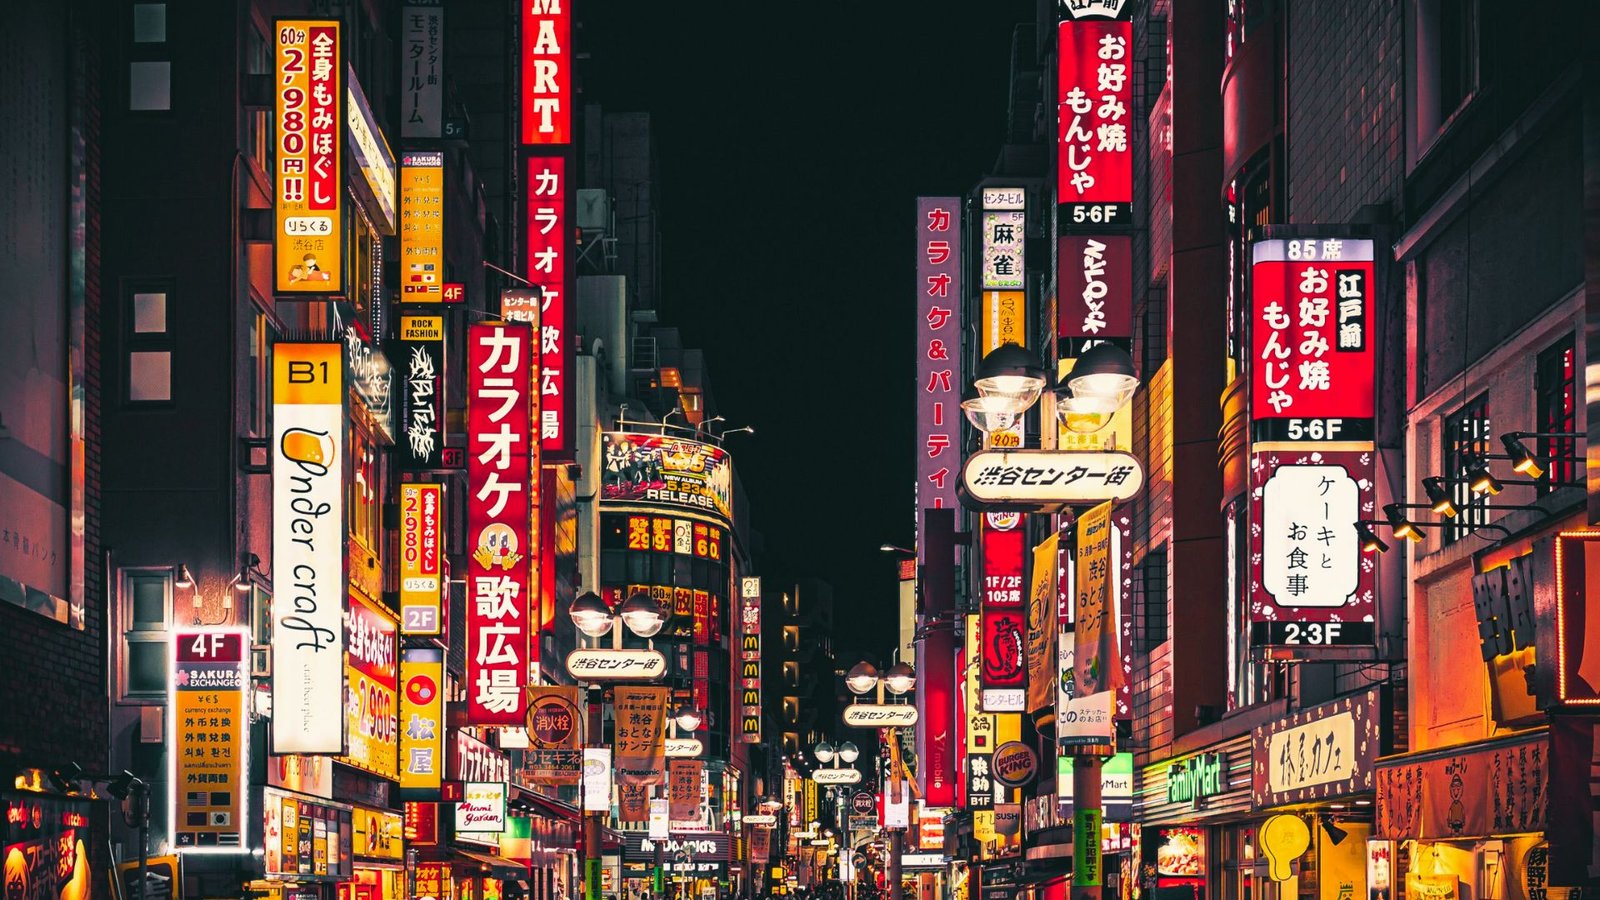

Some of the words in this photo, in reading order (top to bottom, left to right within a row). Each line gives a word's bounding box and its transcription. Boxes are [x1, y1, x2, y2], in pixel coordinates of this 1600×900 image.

[280, 28, 306, 45] 60分
[427, 15, 439, 86] 渋谷センター街
[408, 14, 425, 124] モニタールーム
[1097, 33, 1127, 153] お好み焼
[312, 32, 334, 205] 全身もみほぐし
[1064, 86, 1095, 195] もんじゃ
[983, 193, 1024, 205] センタービル
[1012, 212, 1024, 222] 5F
[288, 219, 330, 233] りらくる
[292, 238, 325, 252] 渋谷店
[993, 223, 1014, 276] 麻雀
[444, 287, 463, 300] 4F
[1338, 273, 1363, 349] 江戸前
[411, 319, 433, 328] ROCK
[1299, 266, 1330, 392] お好み焼
[406, 329, 439, 338] FASHION
[926, 208, 951, 510] カラオケ&パーティー
[1261, 301, 1294, 415] もんじゃ
[288, 360, 328, 384] B1
[476, 327, 522, 519] カラオケ
[991, 435, 1020, 447] 90円
[444, 452, 461, 466] 3F
[681, 477, 702, 485] ALBUM
[973, 465, 1136, 487] 渋谷センター街
[667, 480, 700, 495] 5.23
[647, 488, 714, 508] RELEASE
[993, 512, 1015, 523] KING
[1316, 475, 1336, 570] ケーキと
[423, 491, 436, 572] 全身もみほぐし
[1286, 521, 1310, 598] お食事
[405, 580, 434, 590] りらくる
[985, 576, 1022, 588] 1F/2F
[986, 590, 1021, 603] 105席
[280, 564, 336, 653] craft
[408, 610, 433, 627] 2F
[191, 633, 225, 658] 4F
[474, 575, 521, 714] 歌広場
[572, 658, 660, 670] 渋谷センター街
[190, 670, 241, 679] SAKURA
[190, 678, 234, 687] EXCHANGE
[983, 694, 1024, 707] センタービル
[536, 715, 569, 731] 消火栓
[629, 713, 653, 726] 渋谷
[1060, 711, 1077, 724] この
[618, 726, 662, 739] おとなり
[406, 714, 437, 774] 松屋
[618, 741, 663, 752] サンデー
[664, 744, 699, 752] ンター街
[998, 751, 1030, 765] BURGER
[621, 768, 660, 777] Panasonic
[1000, 760, 1032, 775] KING
[1167, 752, 1222, 811] FamilyMart
[457, 803, 492, 812] Miami
[970, 796, 991, 807] B1F
[995, 812, 1018, 821] SUSHI
[641, 839, 716, 854] MDold's
